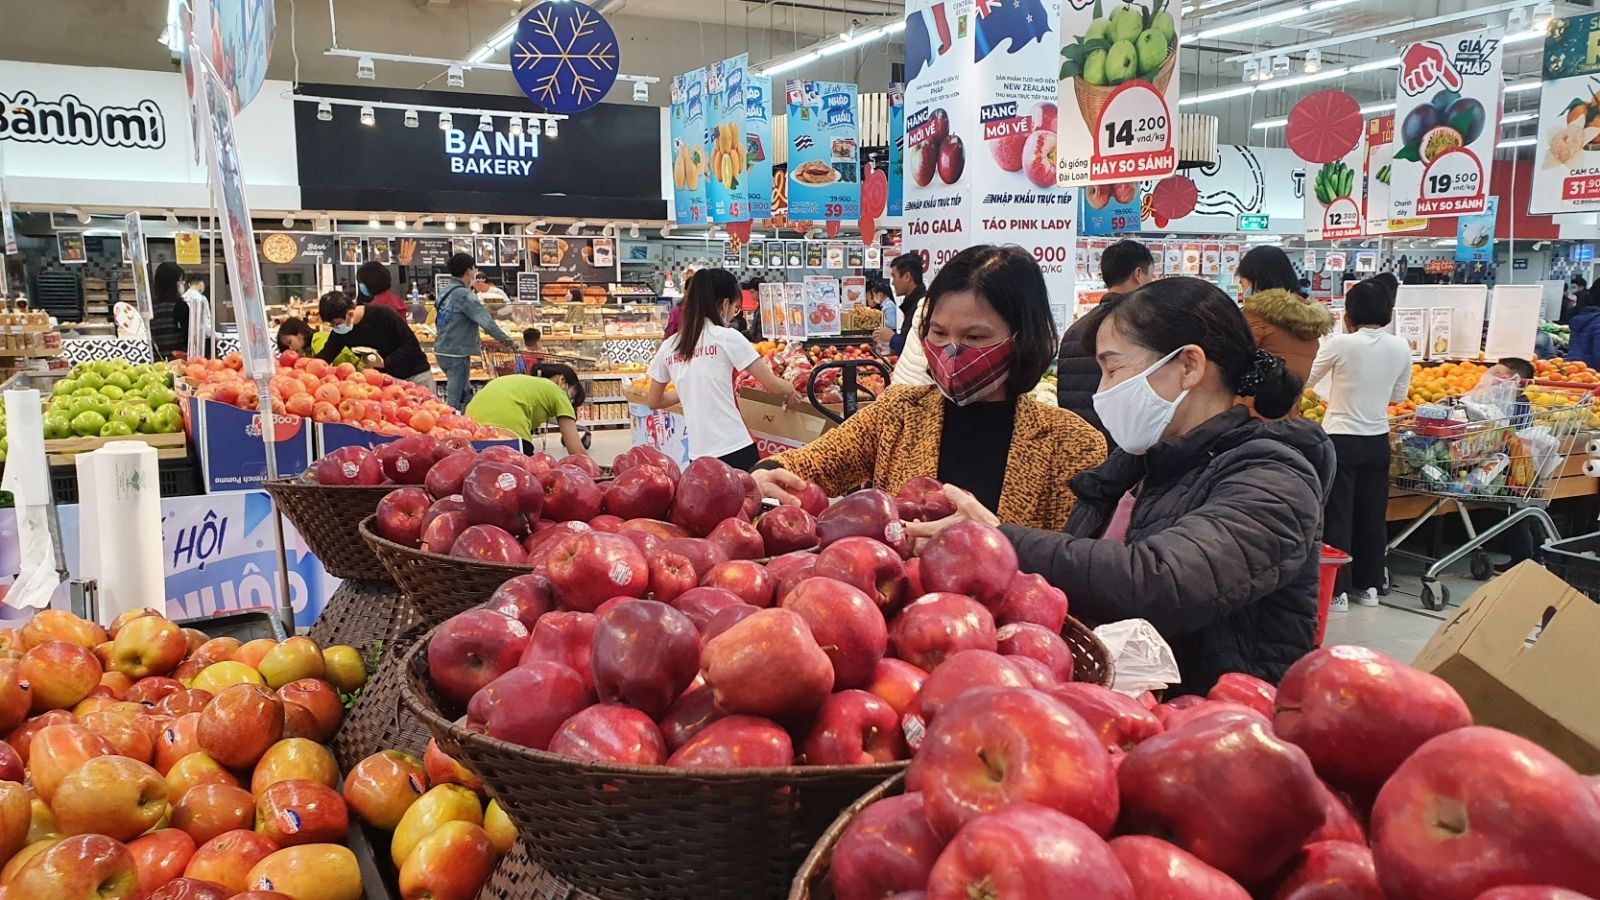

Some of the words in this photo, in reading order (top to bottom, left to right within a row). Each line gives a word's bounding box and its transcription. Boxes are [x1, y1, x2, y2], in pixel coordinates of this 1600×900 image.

[1458, 34, 1483, 53] GIÁ
[1003, 83, 1021, 91] NEW
[1022, 84, 1056, 93] ZEALAND
[981, 105, 1016, 120] HÀNG
[105, 105, 159, 142] mì
[907, 112, 929, 129] HÀNG
[986, 121, 1011, 138] MỚI
[1013, 117, 1029, 133] VỀ
[1105, 119, 1134, 148] 14
[1136, 133, 1165, 143] vnd/kg
[450, 157, 533, 176] BAKERY
[1068, 157, 1088, 170] giống
[1119, 160, 1136, 173] SO
[1137, 154, 1172, 170] SÁNH
[1071, 172, 1088, 180] Loan
[1429, 174, 1452, 194] 19
[1569, 181, 1586, 195] 31
[990, 194, 1013, 207] NHẬP
[1014, 189, 1035, 205] KHẨU
[1036, 192, 1056, 208] TRỰC
[1056, 190, 1073, 205] TIẾP
[1440, 201, 1453, 210] SO
[1455, 197, 1483, 208] SÁNH
[825, 203, 843, 217] 39
[908, 217, 930, 236] TÁO
[932, 218, 963, 235] GALA
[982, 216, 1007, 230] TÁO
[1010, 219, 1038, 230] PINK
[1041, 219, 1072, 230] LADY
[1111, 216, 1125, 230] 59
[1329, 213, 1342, 226] 12
[214, 476, 242, 484] Pomme
[173, 509, 228, 570] HỘI
